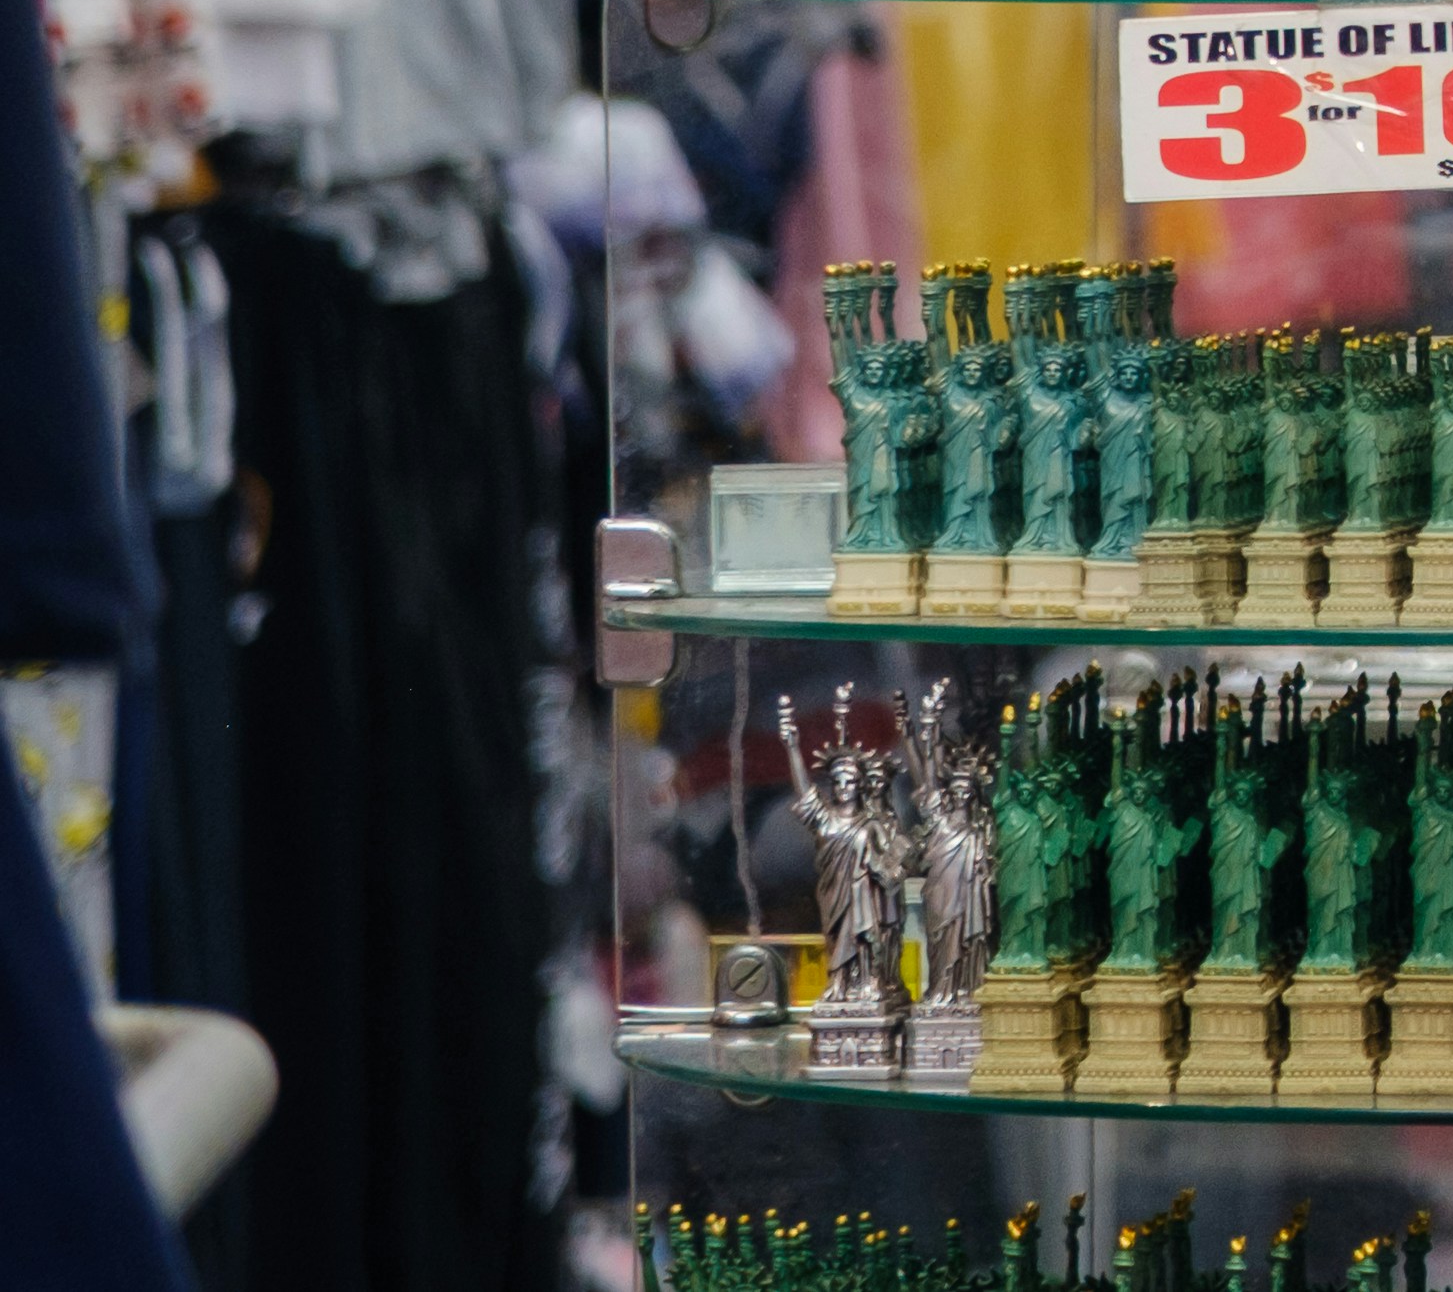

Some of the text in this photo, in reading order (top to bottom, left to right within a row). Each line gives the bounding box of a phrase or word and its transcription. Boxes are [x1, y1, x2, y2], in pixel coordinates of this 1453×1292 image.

[1147, 26, 1325, 65] STATUE
[1338, 23, 1396, 58] OF
[1157, 68, 1307, 181] 3
[1307, 103, 1362, 123] for
